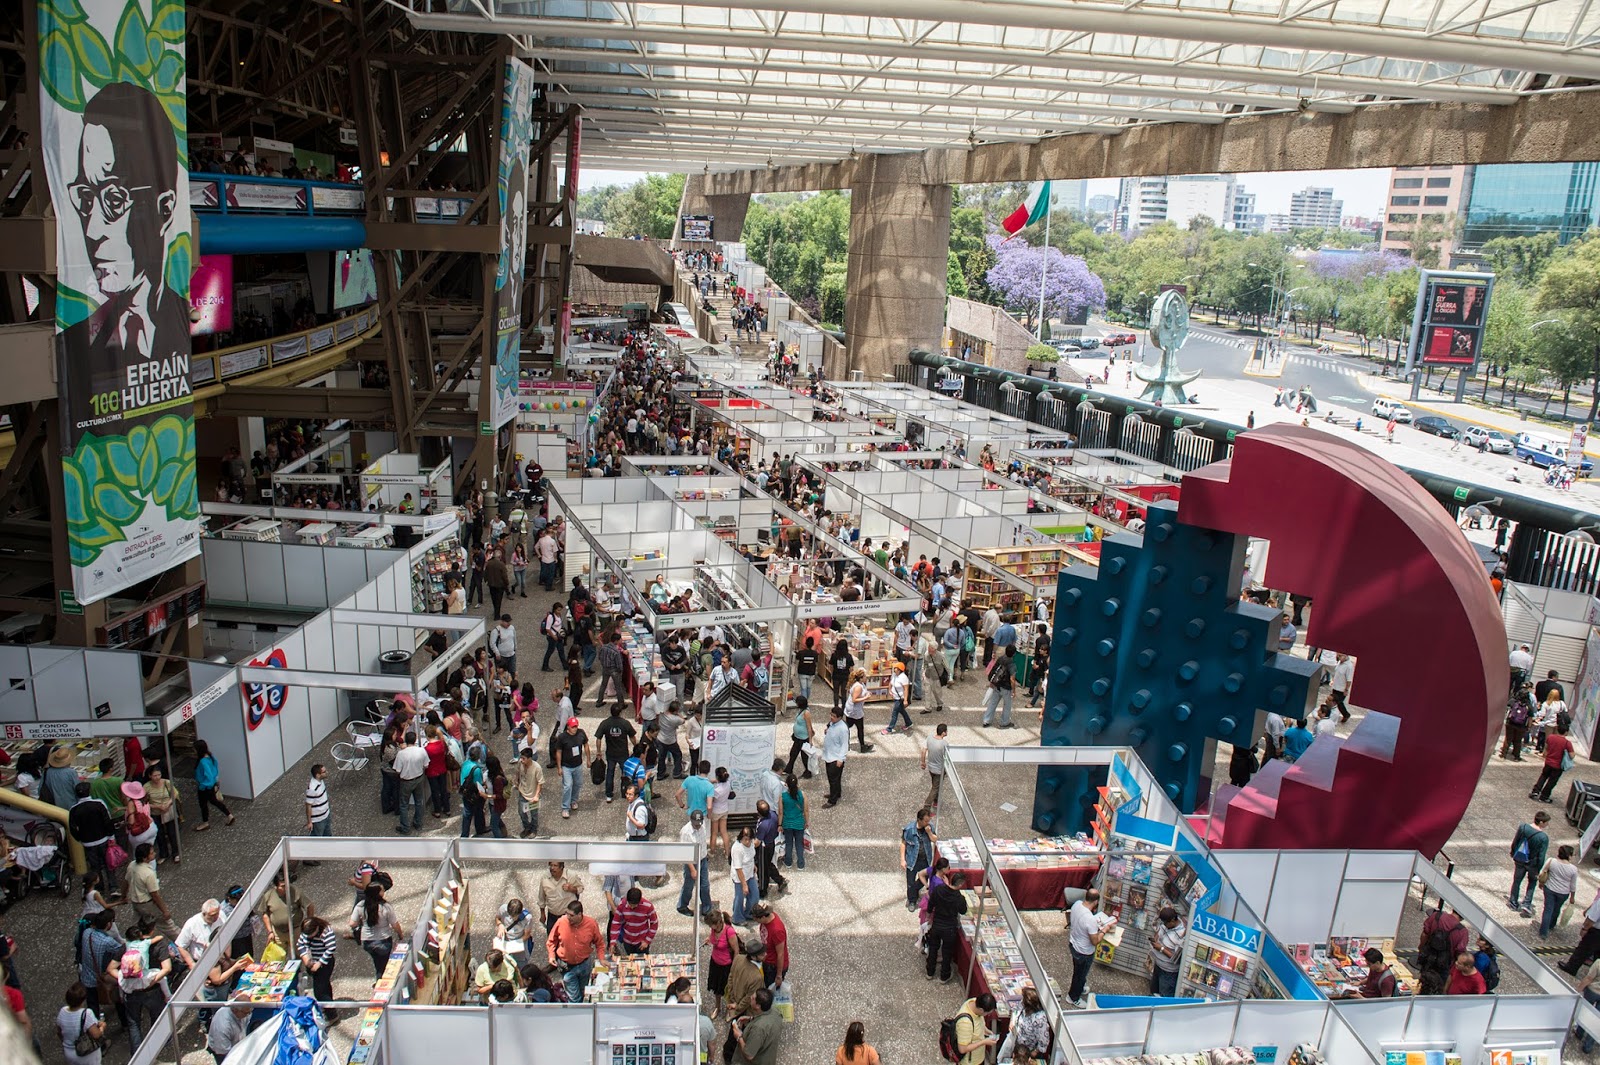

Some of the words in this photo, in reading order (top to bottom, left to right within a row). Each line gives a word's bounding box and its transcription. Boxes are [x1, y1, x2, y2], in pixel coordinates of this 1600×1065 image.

[126, 351, 189, 386] EFRAÍN
[89, 390, 119, 415] 100
[122, 376, 191, 410] HUERTA
[76, 418, 106, 428] CULTURA
[125, 541, 148, 554] ENTRADA
[149, 534, 162, 545] LIBRE
[714, 613, 746, 621] Alfaomega
[200, 686, 215, 698] FONDO
[201, 687, 222, 703] CULTURA
[1191, 913, 1258, 951] ABADA
